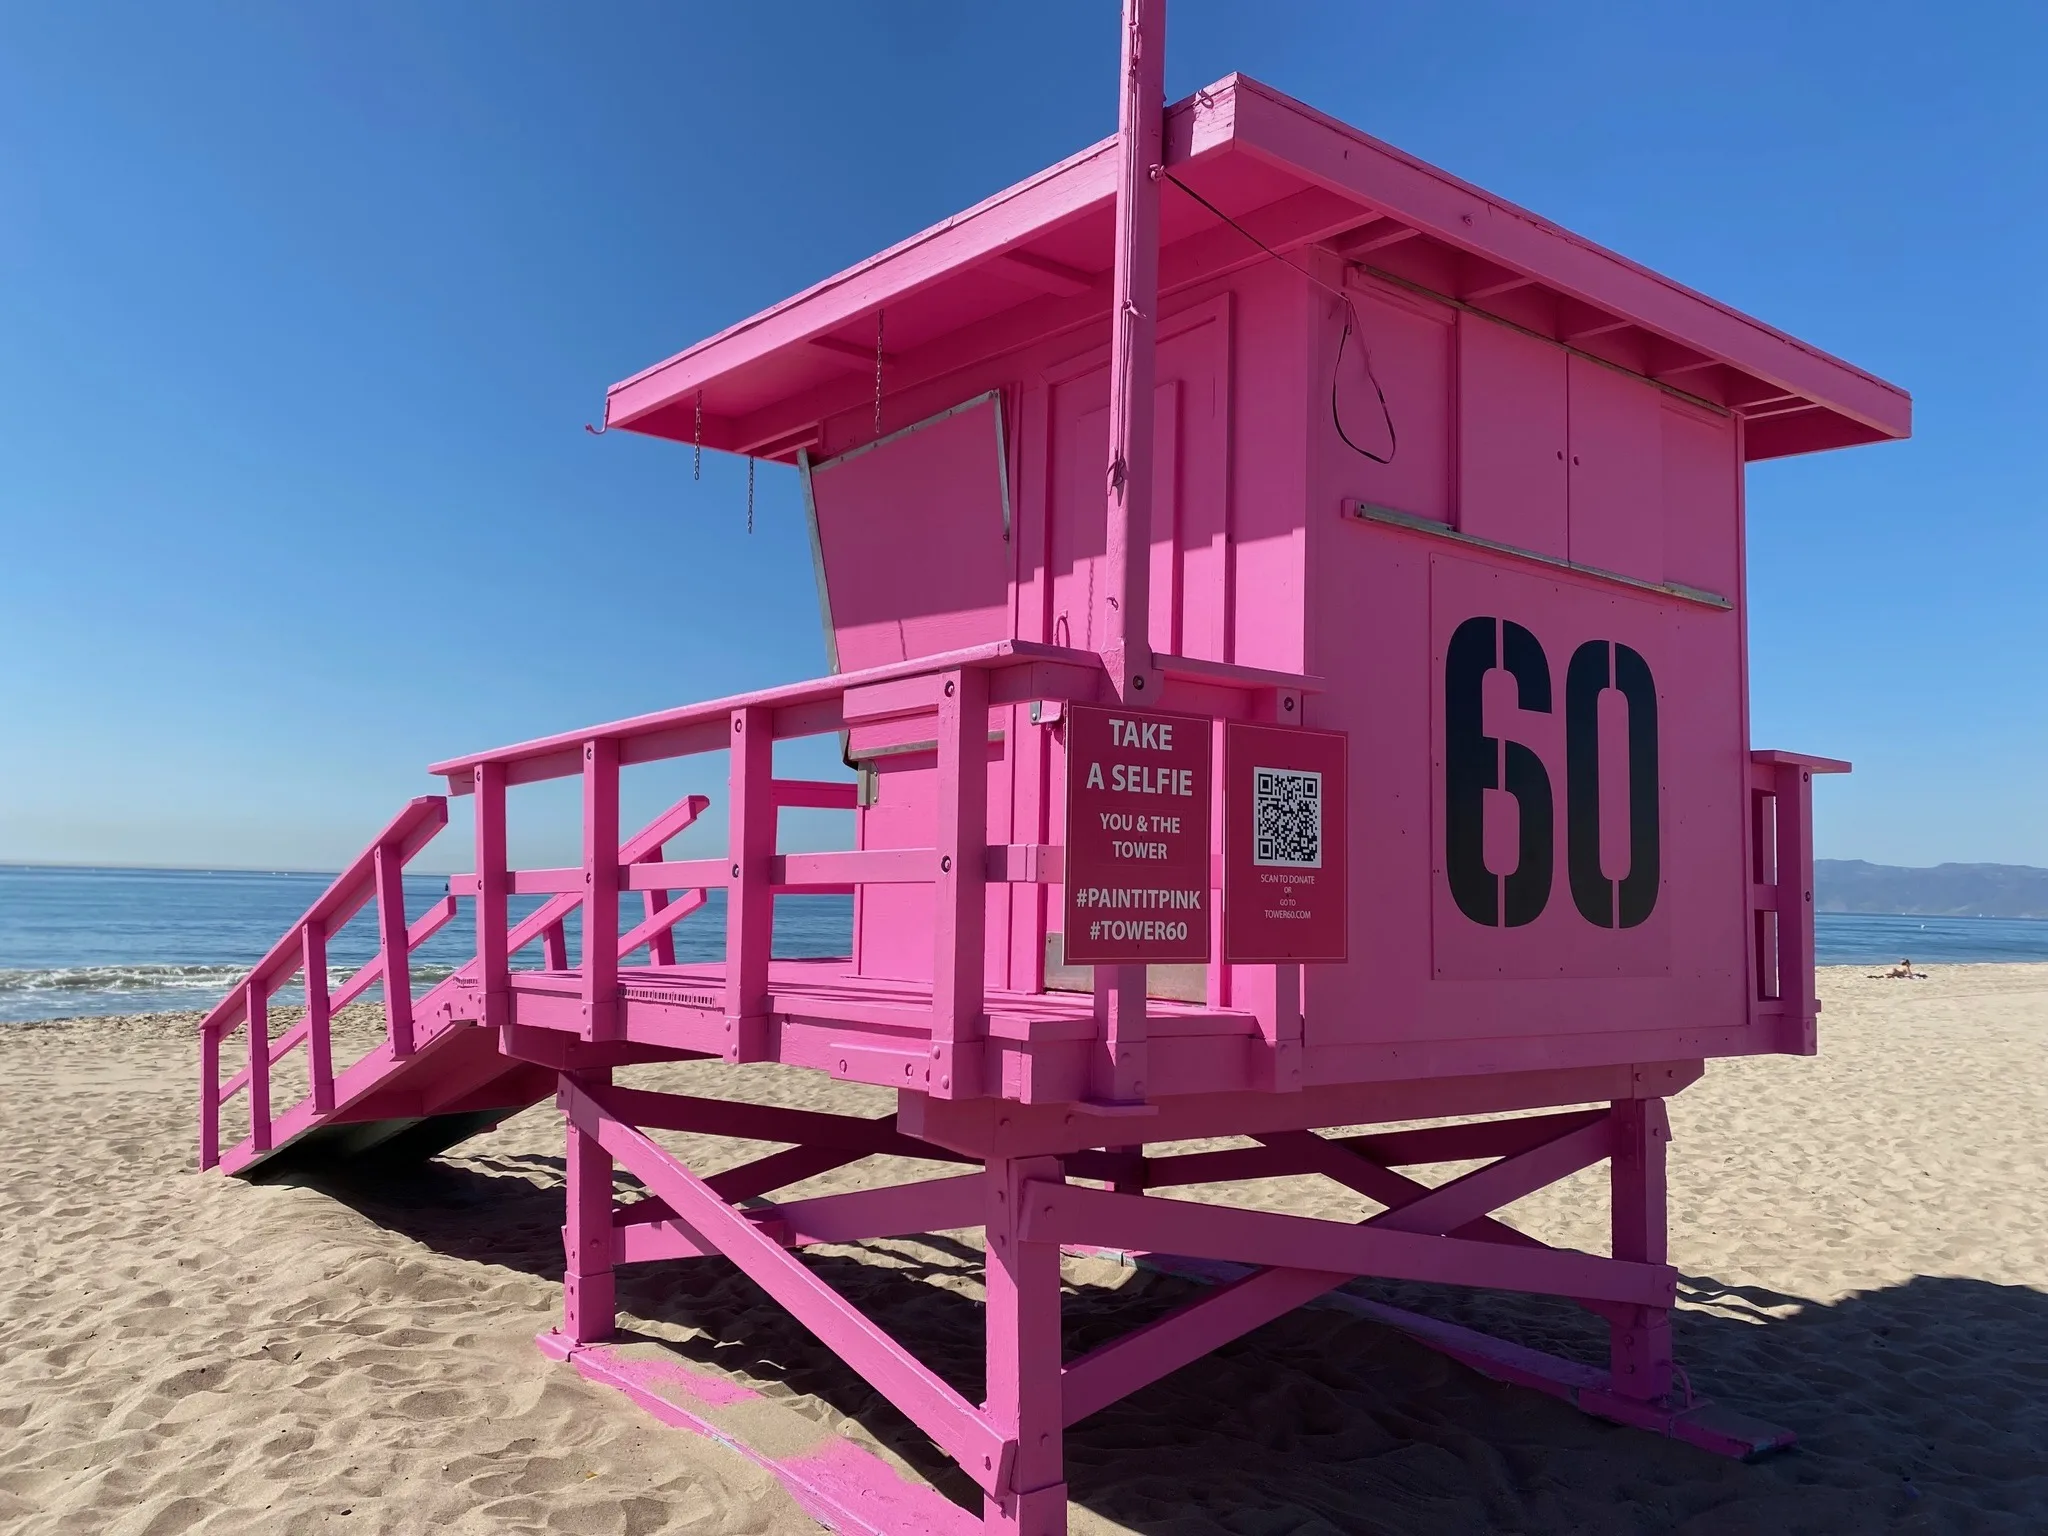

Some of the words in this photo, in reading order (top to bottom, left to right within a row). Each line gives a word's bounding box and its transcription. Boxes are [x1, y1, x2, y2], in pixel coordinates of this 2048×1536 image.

[1109, 719, 1173, 751] TAKE
[1087, 763, 1104, 790] A
[1112, 764, 1193, 796] SELFIE
[1445, 616, 1659, 928] 60
[1100, 813, 1132, 832] YOU
[1137, 814, 1148, 832] &
[1150, 815, 1181, 834] THE
[1113, 841, 1168, 860] TOWER
[1261, 874, 1279, 883] SCAN
[1280, 875, 1288, 884] TO
[1289, 875, 1314, 884] DONATE
[1076, 888, 1202, 910] #PAINTITPINK
[1265, 910, 1311, 919] TOWER60.COM
[1090, 920, 1188, 941] #TOWER60
